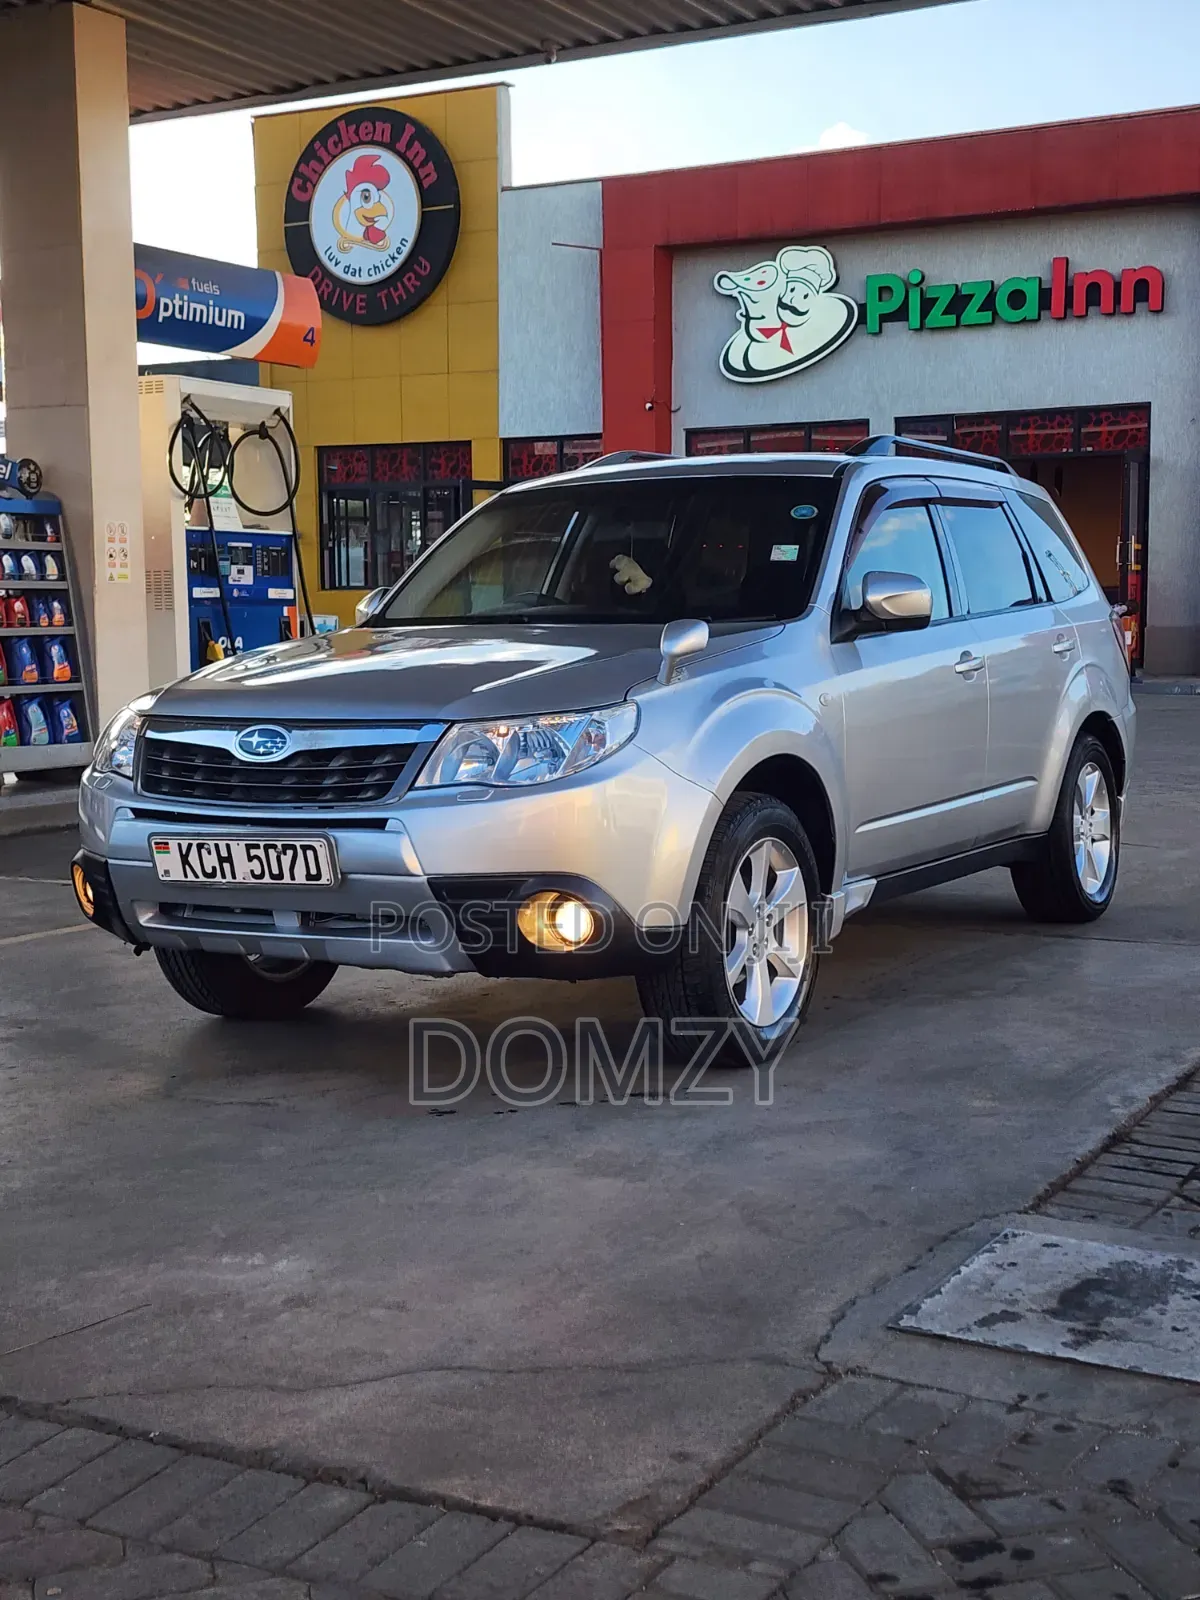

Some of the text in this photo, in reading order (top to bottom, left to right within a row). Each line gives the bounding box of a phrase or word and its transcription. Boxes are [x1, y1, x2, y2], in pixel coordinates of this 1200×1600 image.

[291, 120, 439, 202] Chicken Inn
[324, 237, 409, 278] luv dat chicken
[191, 277, 221, 295] fuels
[307, 256, 432, 314] DRIVE THRU
[302, 327, 316, 347] 4
[177, 842, 323, 882] KCH 507D
